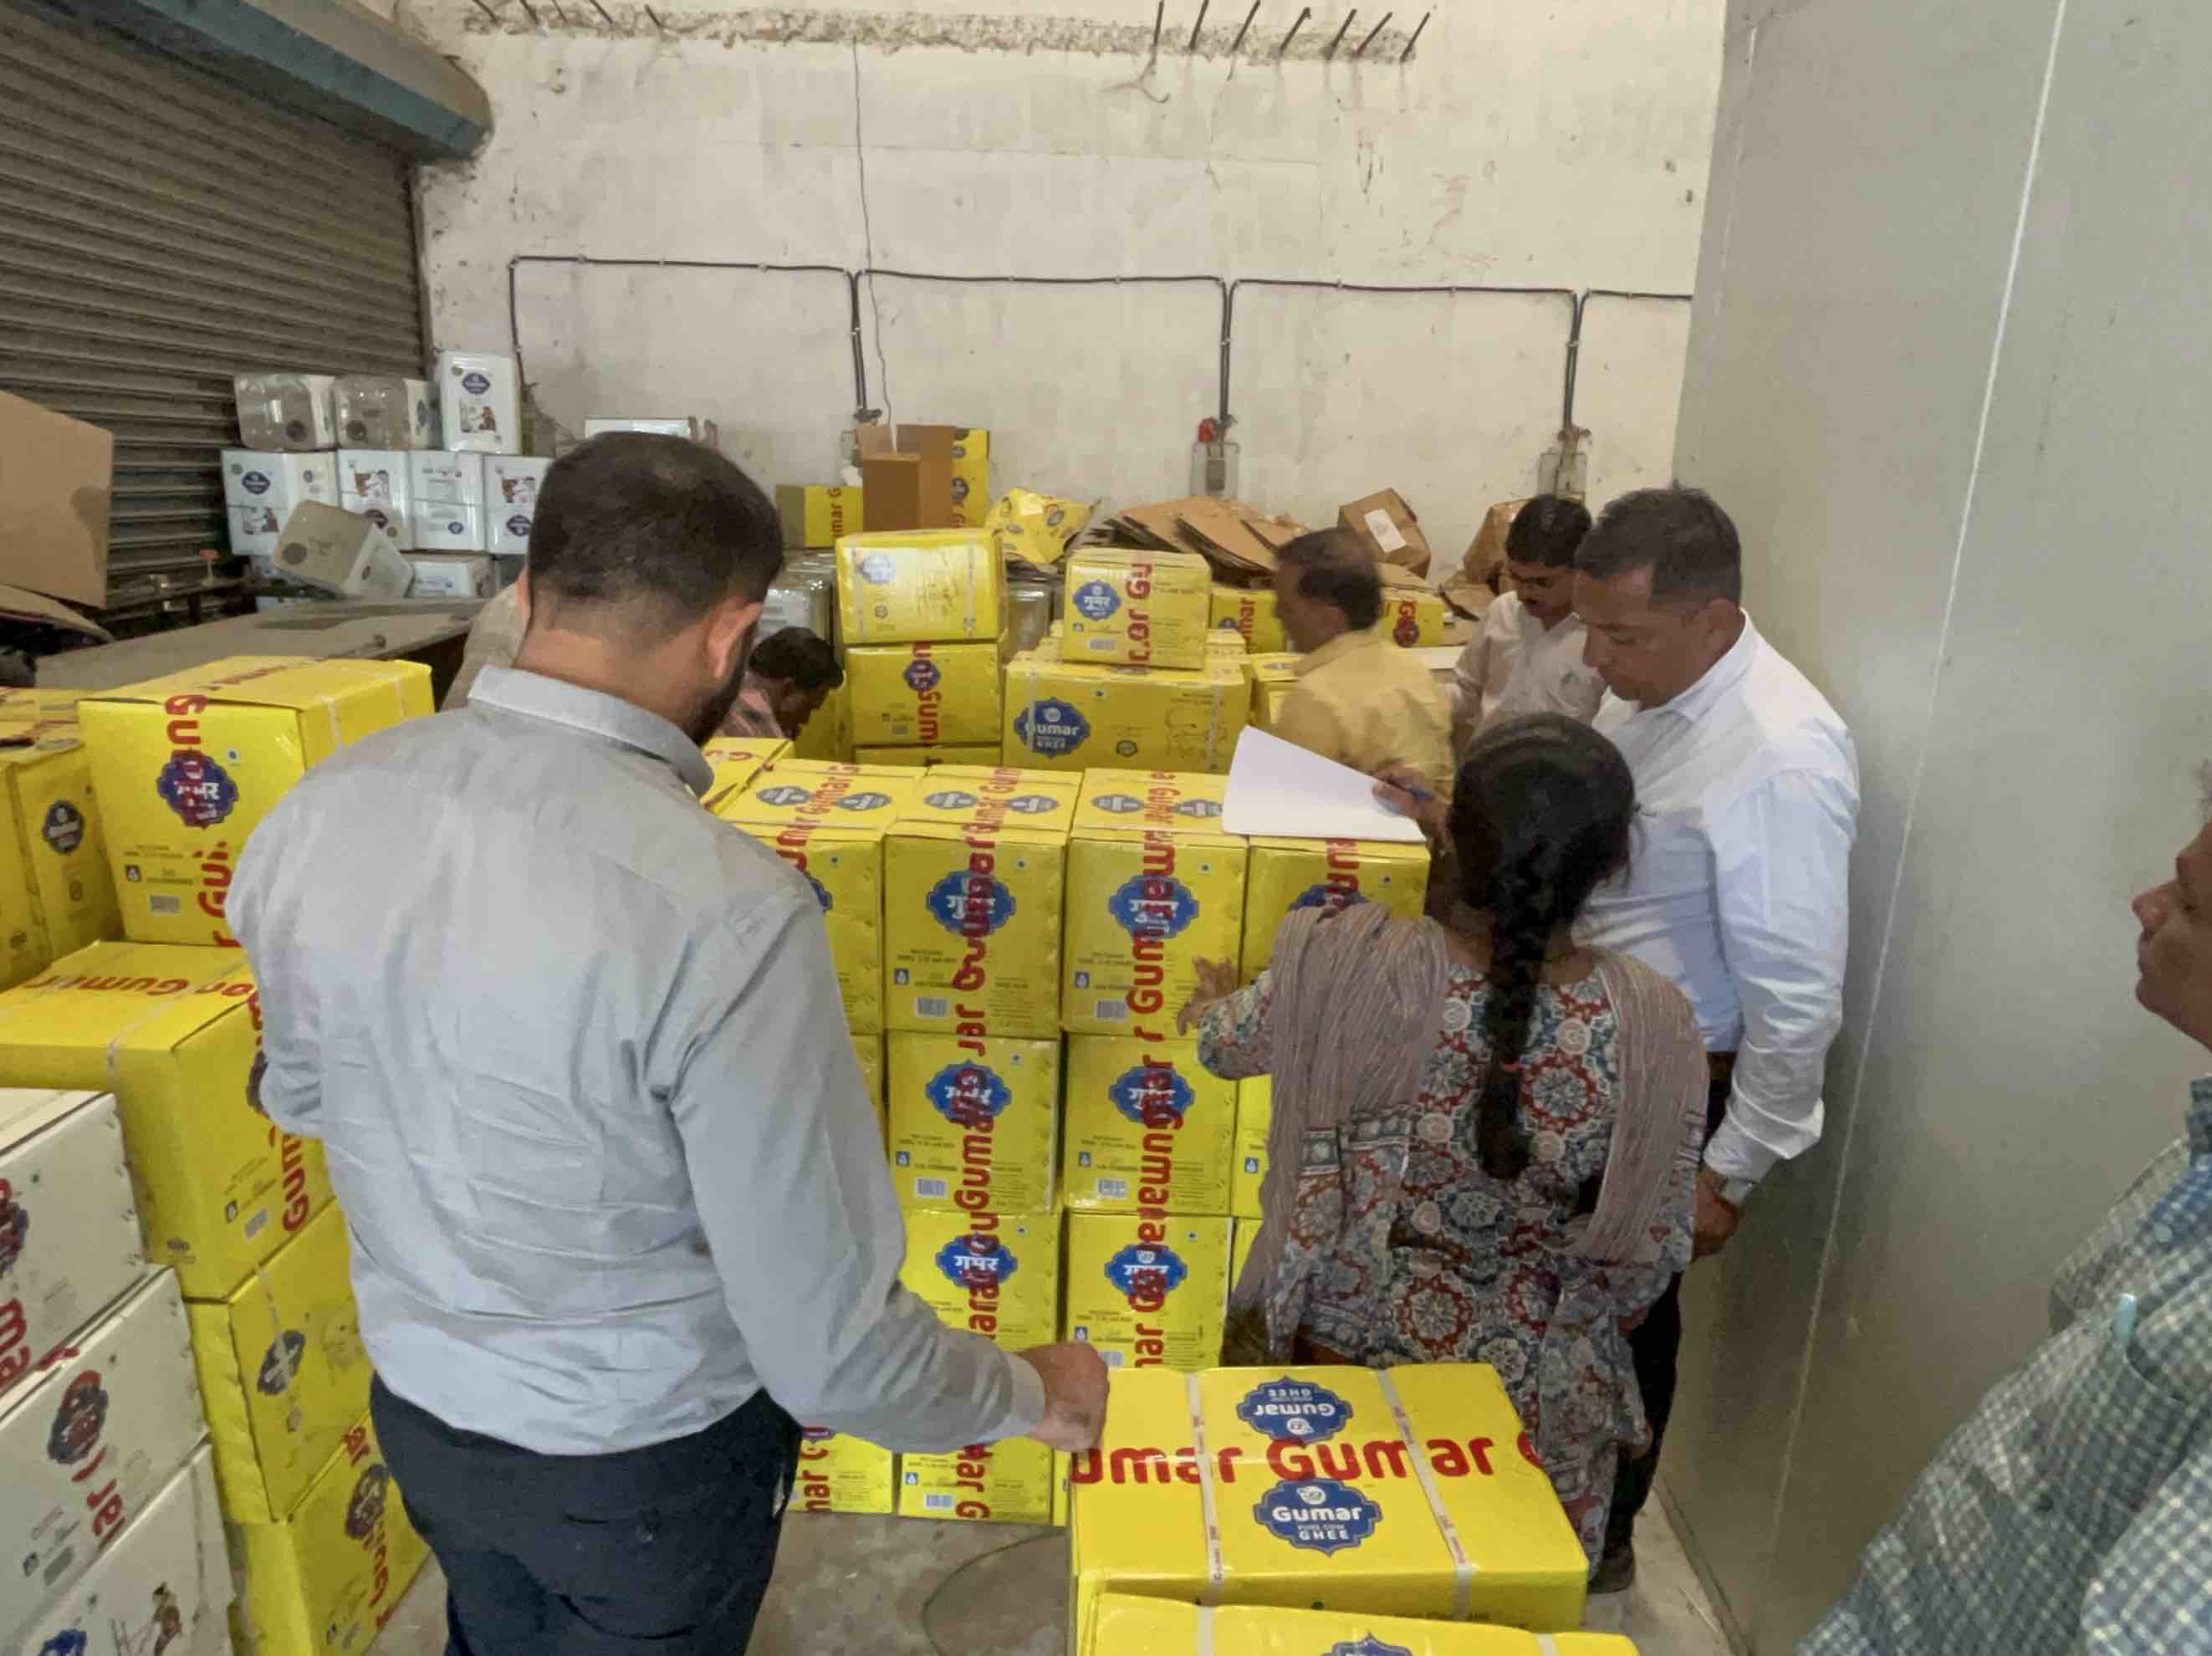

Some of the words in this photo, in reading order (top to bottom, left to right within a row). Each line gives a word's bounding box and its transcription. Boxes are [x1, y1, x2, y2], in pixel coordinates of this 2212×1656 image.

[1254, 1403, 1336, 1417] Gumar
[1265, 1436, 1494, 1482] Gumar
[1271, 1506, 1363, 1523] Gumar
[1298, 1531, 1350, 1541] GHEE
